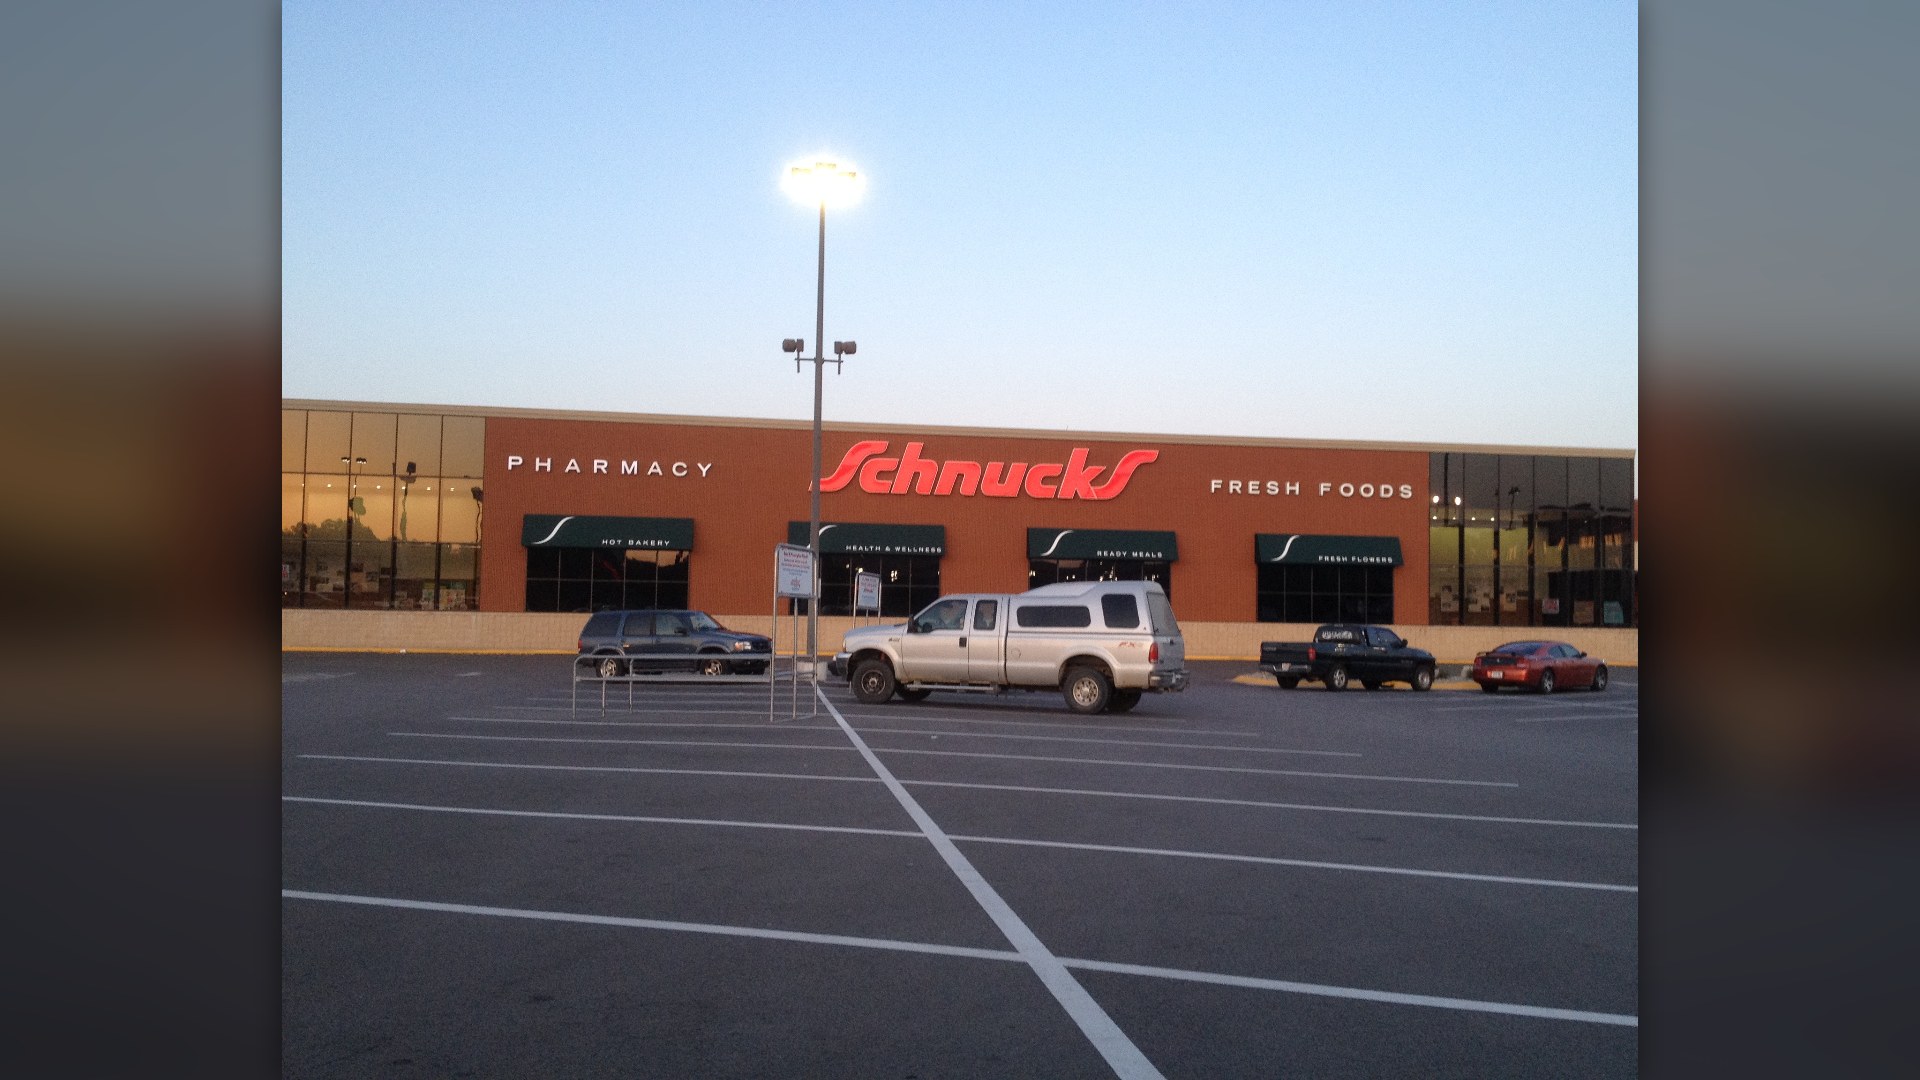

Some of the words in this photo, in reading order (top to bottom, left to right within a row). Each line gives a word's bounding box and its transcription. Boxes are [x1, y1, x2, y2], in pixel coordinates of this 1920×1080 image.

[507, 455, 712, 477] PHARMACY
[1210, 479, 1300, 496] FRESH
[1319, 482, 1413, 499] FOODS
[628, 539, 670, 547] BAKERY
[1096, 550, 1127, 558] READY
[1132, 551, 1163, 559] MEALS
[1351, 556, 1393, 564] FLOWERS
